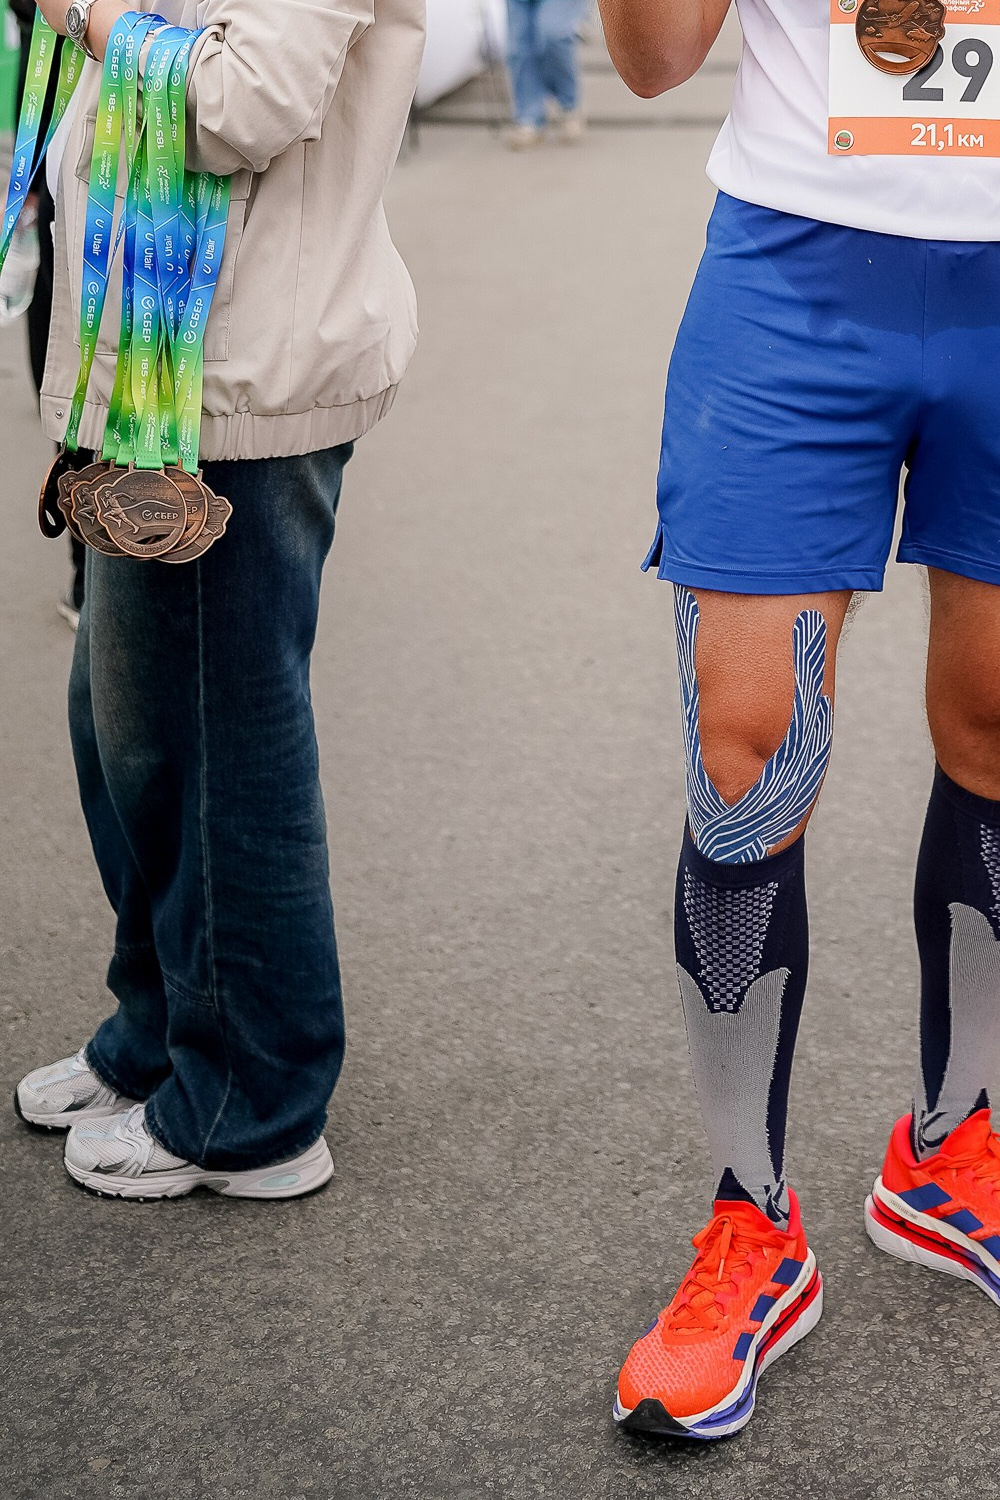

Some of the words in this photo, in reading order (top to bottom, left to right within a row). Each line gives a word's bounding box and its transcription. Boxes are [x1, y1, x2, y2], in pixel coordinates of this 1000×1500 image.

[34, 59, 43, 78] 185
[39, 38, 47, 57] лет
[110, 48, 119, 79] СБЕР
[157, 48, 171, 76] СБЕР
[67, 66, 75, 84] 185
[903, 38, 993, 102] 29
[107, 92, 117, 112] 185
[105, 115, 114, 135] лет
[910, 122, 954, 151] 21,1
[957, 133, 984, 148] км
[155, 129, 165, 150] 185
[16, 156, 26, 178] Utair
[92, 233, 103, 256] Utair
[164, 234, 173, 257] Utair
[204, 238, 216, 260] Utair
[143, 247, 154, 271] Utair
[86, 297, 97, 329] СБЕР
[189, 298, 204, 328] СБЕР
[142, 312, 153, 343] СБЕР
[141, 357, 149, 377] 185
[177, 357, 187, 378] лет
[154, 512, 179, 520] СБЕР
[186, 506, 198, 514] ЕР
